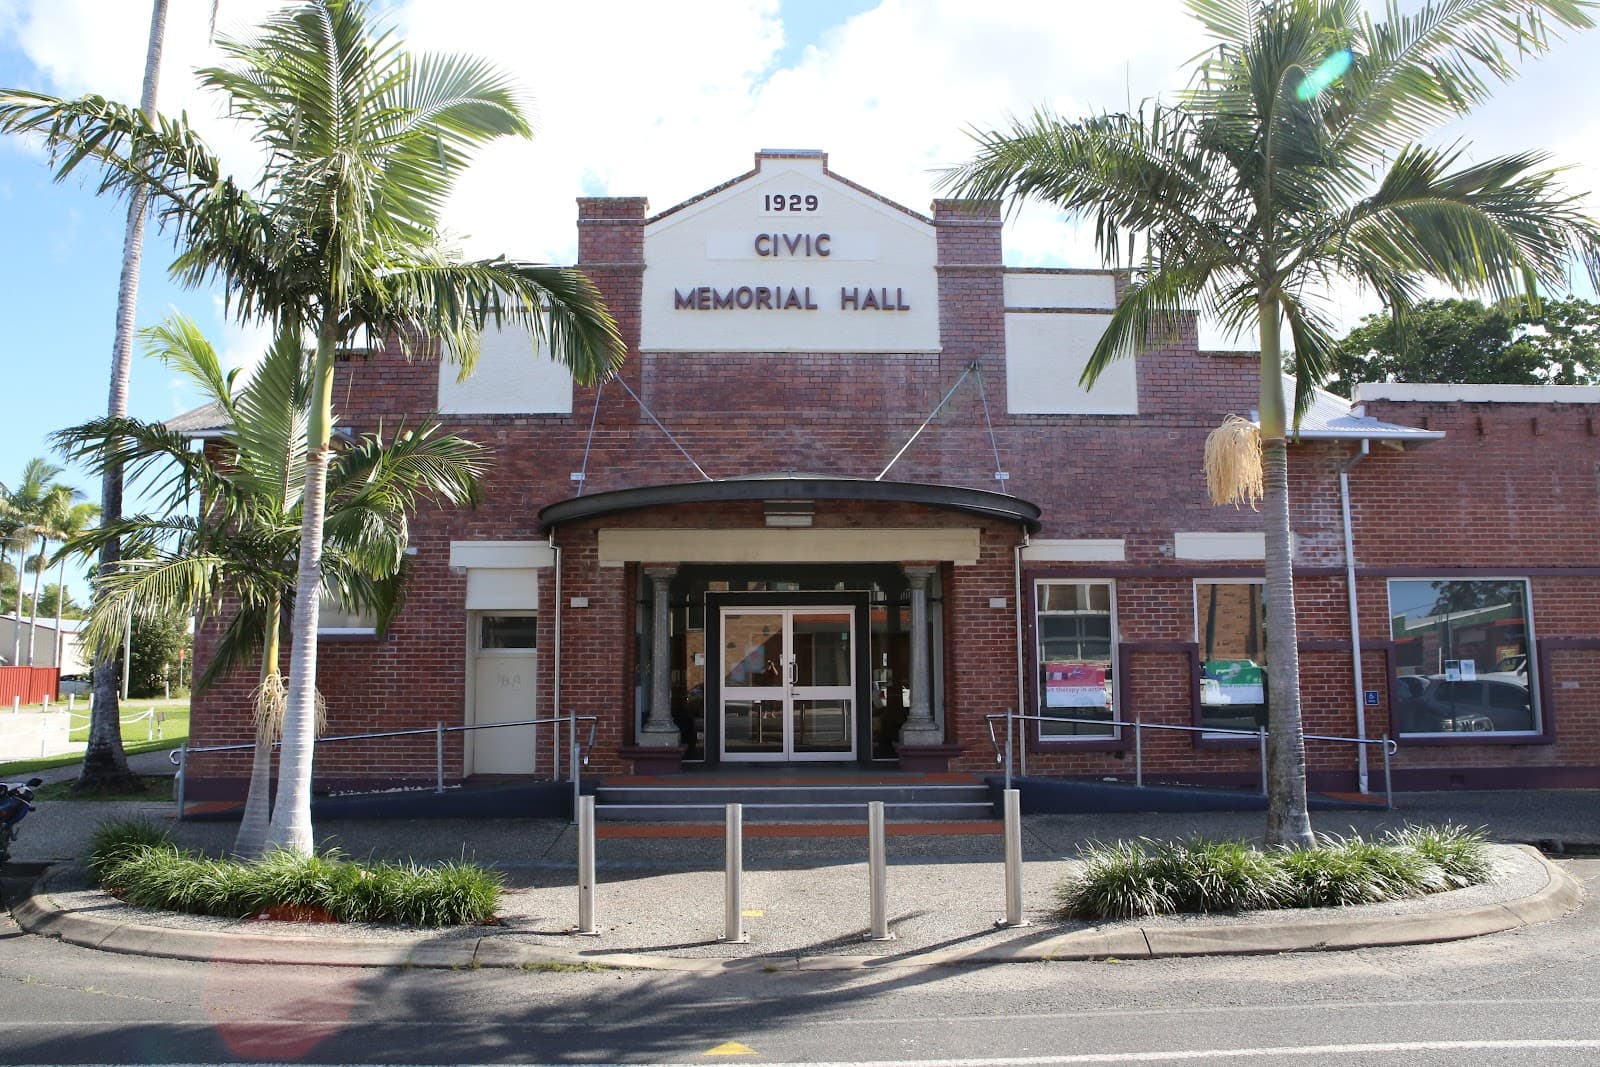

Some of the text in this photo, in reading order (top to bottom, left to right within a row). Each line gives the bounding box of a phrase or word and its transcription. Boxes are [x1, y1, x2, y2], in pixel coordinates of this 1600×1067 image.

[764, 194, 819, 212] 1929
[754, 233, 831, 257] CIVIC
[674, 286, 911, 311] MEMORIAL HALL
